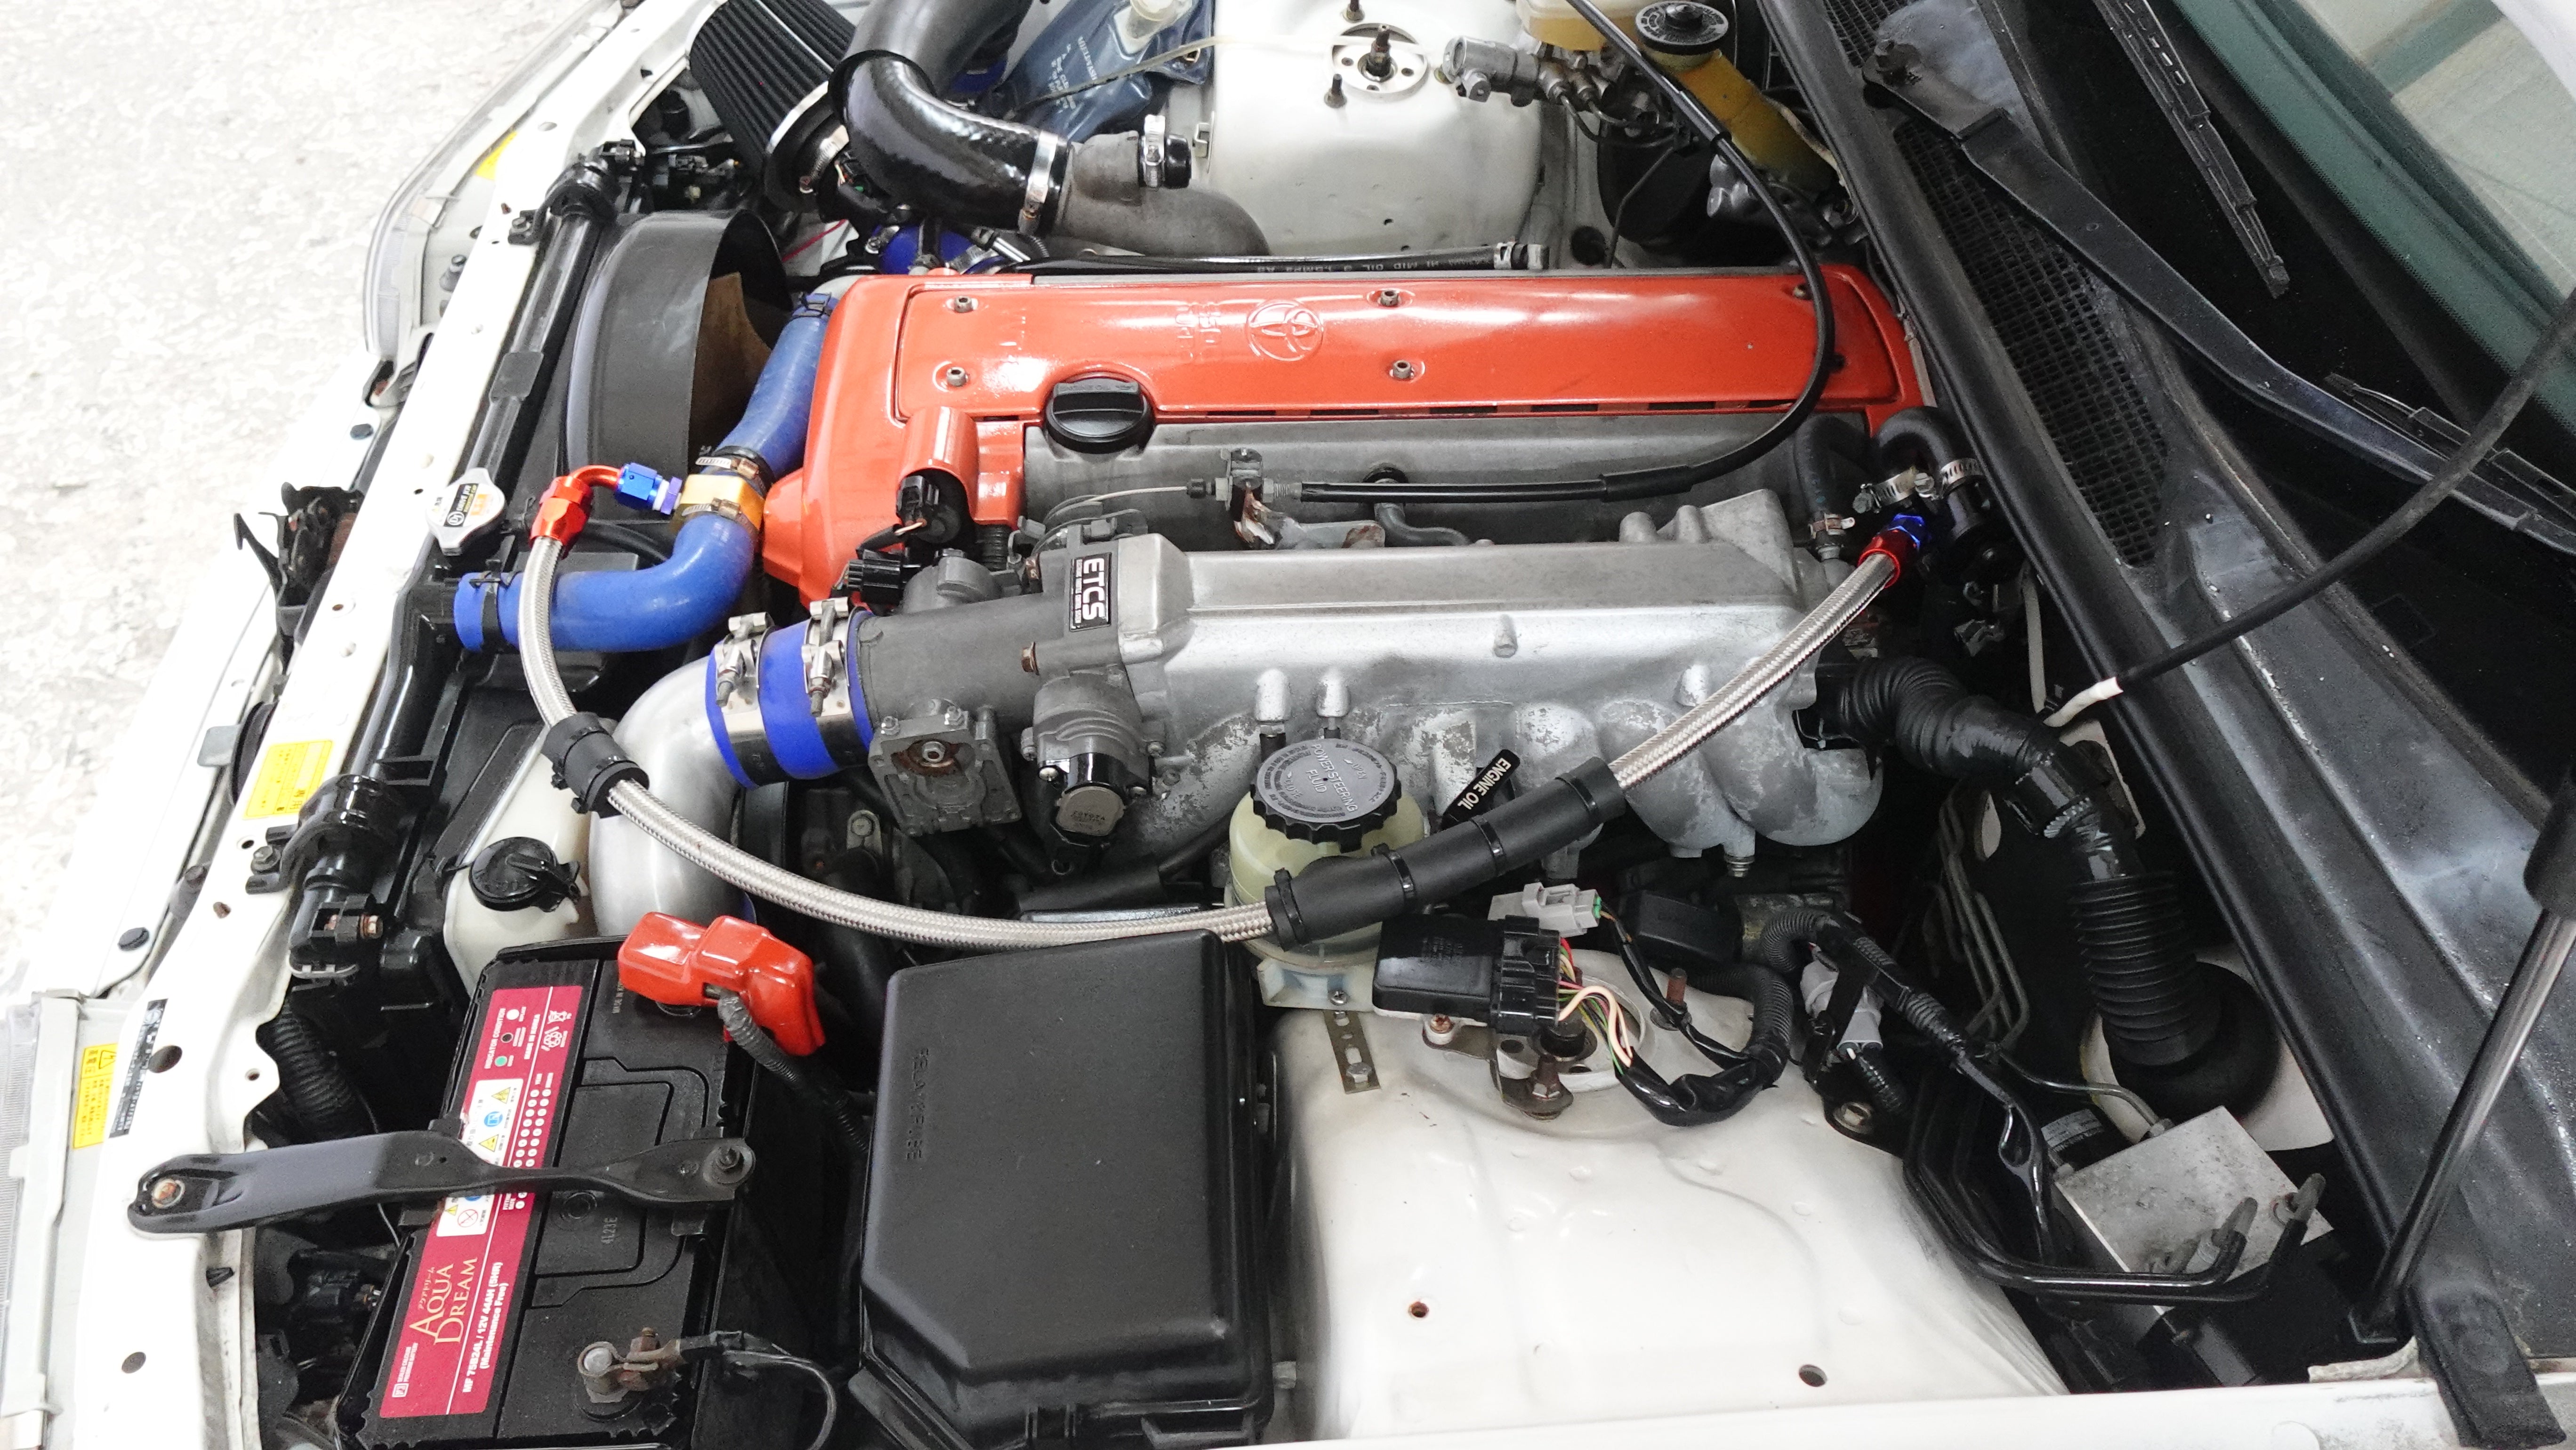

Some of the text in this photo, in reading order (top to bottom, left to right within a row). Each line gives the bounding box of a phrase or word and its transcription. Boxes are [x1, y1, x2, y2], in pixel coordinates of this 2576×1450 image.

[1083, 558, 1105, 620] ETCS
[1284, 779, 1303, 799] CLOSE
[1306, 769, 1327, 793] FLUID
[1311, 743, 1335, 772] POWER
[1328, 771, 1358, 812] STEERING
[1352, 764, 1367, 780] OPEN
[1457, 757, 1512, 810] ENGINE OIL
[484, 1008, 506, 1069] INDICATOR CONDITION
[524, 1042, 533, 1059] MADE
[530, 1014, 540, 1035] KOREA
[418, 1267, 435, 1309] アクアドリーム
[488, 1262, 503, 1287] (5HR)
[409, 1264, 453, 1337] AQUA
[433, 1257, 478, 1345] DREAM
[483, 1289, 496, 1314] 44AH
[477, 1315, 490, 1333] 12V
[480, 1282, 509, 1369] (Maintenance Free)
[467, 1340, 483, 1376] 75B24L
[462, 1378, 474, 1393] MF
